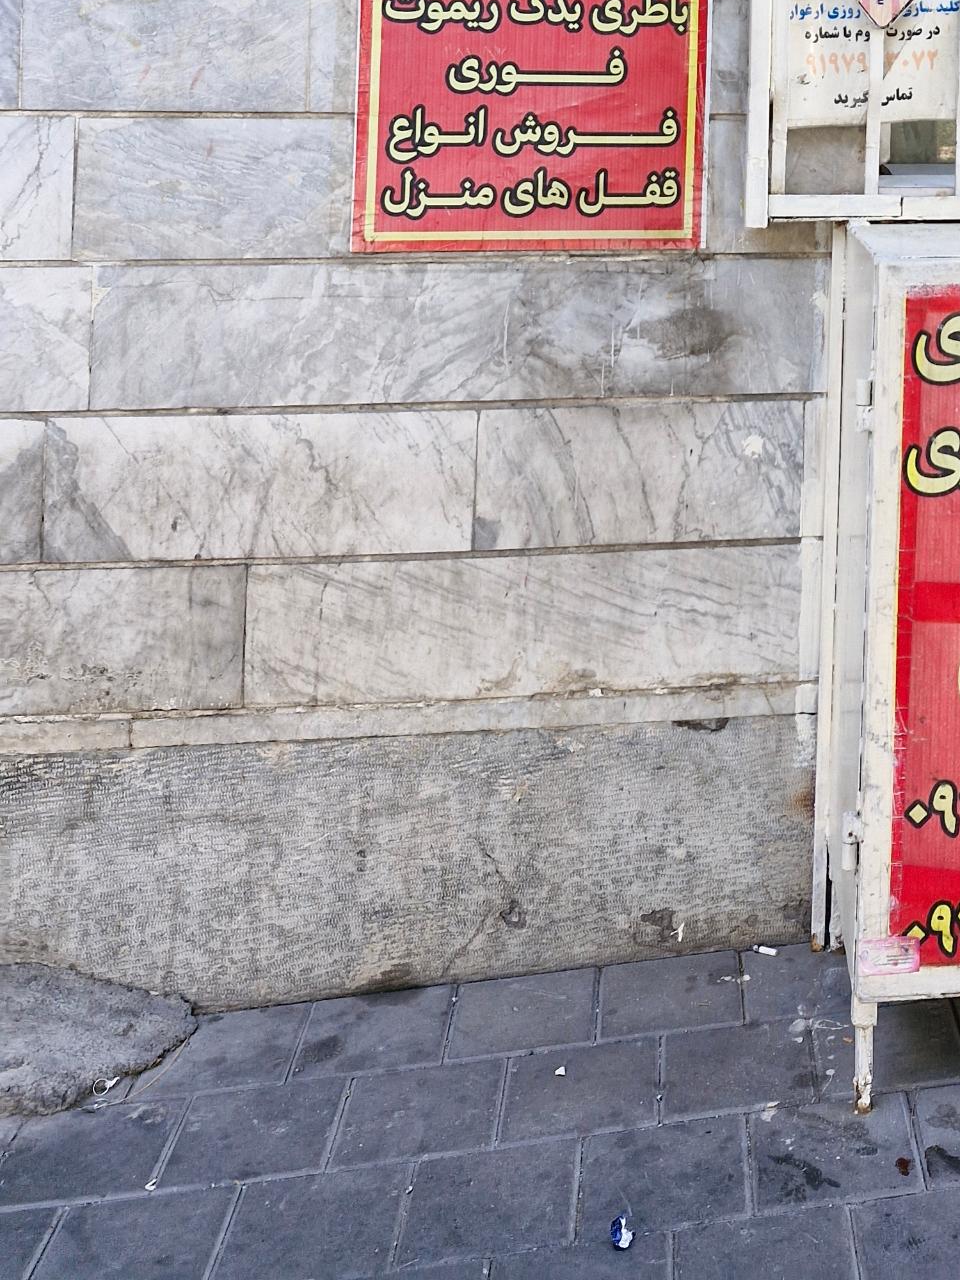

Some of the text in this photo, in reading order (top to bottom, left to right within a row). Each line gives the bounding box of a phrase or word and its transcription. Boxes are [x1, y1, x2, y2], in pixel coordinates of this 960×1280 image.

[805, 26, 839, 43] شماره
[843, 26, 851, 41] با
[886, 27, 923, 41] صورت
[926, 26, 940, 39] در
[448, 47, 627, 94] فوری
[881, 87, 913, 106] تماس
[386, 104, 681, 163] فروش انواع
[382, 166, 680, 219] قفل های منزل
